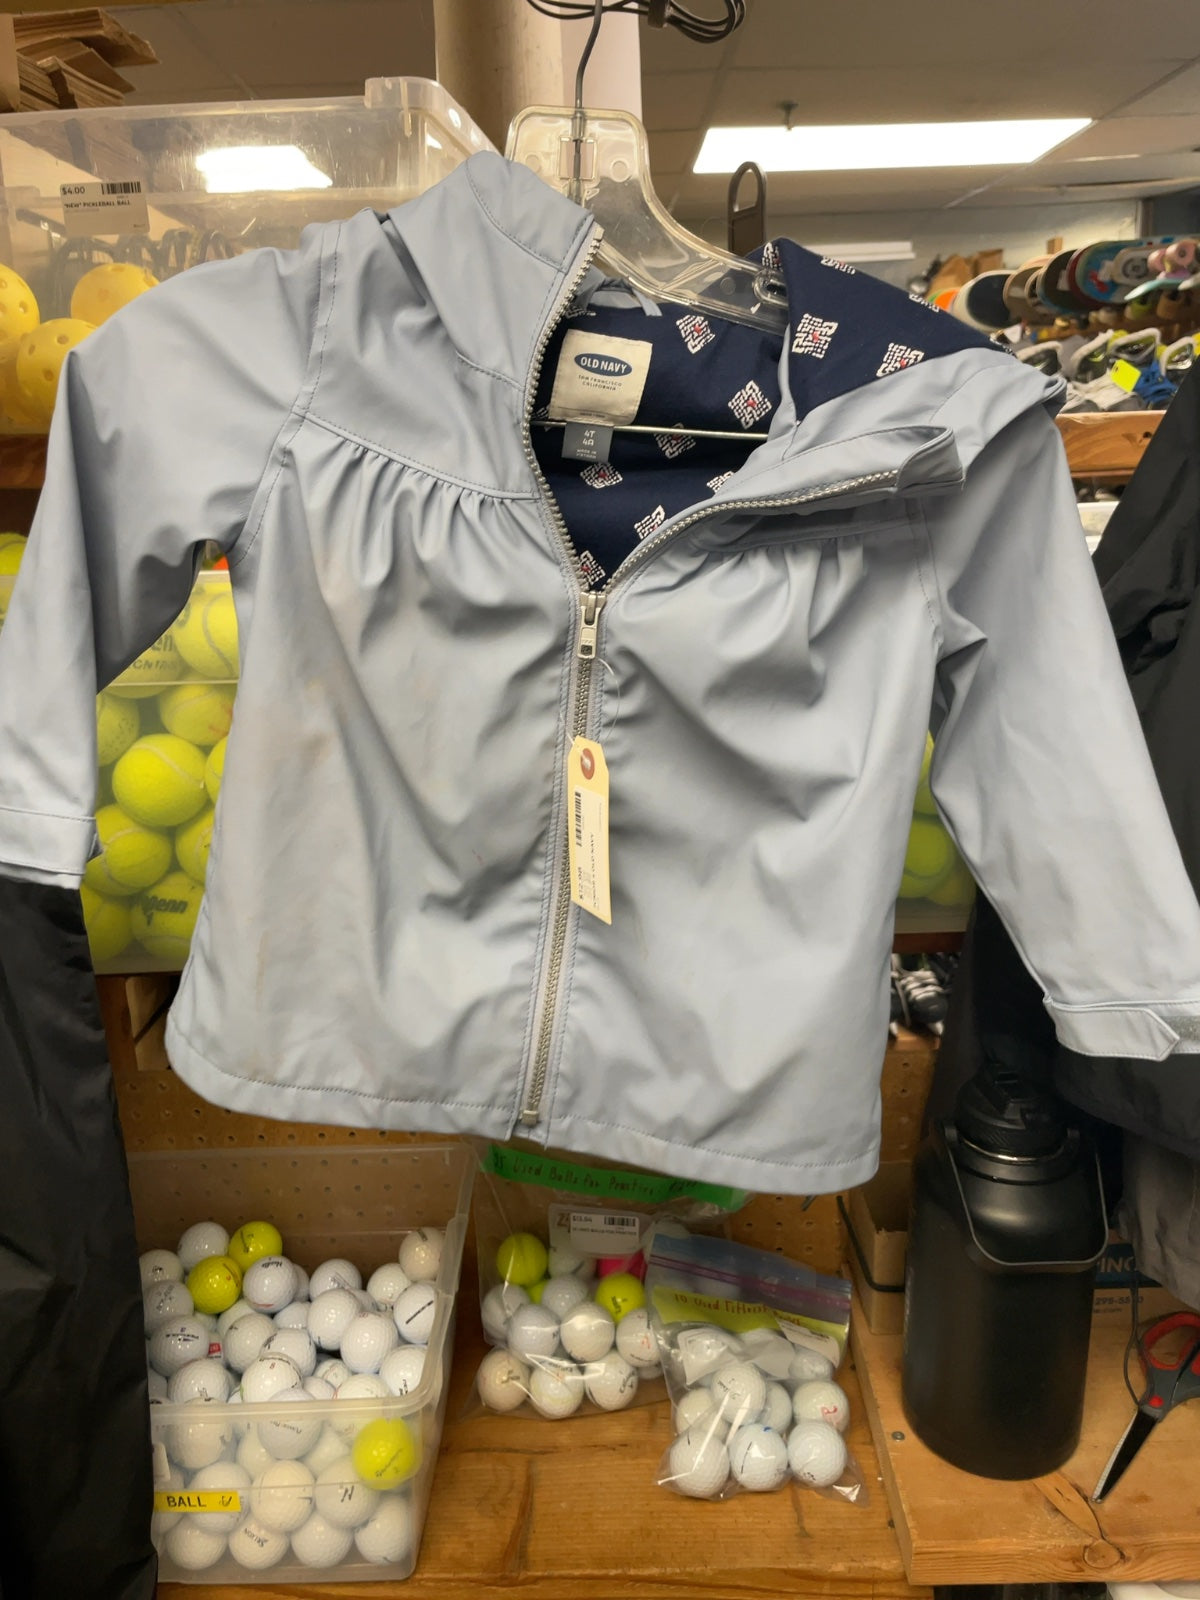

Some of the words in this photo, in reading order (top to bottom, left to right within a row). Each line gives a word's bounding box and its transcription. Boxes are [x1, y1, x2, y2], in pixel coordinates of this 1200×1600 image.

[61, 186, 86, 195] $4.00
[580, 356, 599, 369] OLD
[600, 361, 628, 374] NAVY
[584, 430, 596, 438] 4T
[166, 1495, 207, 1508] BALL
